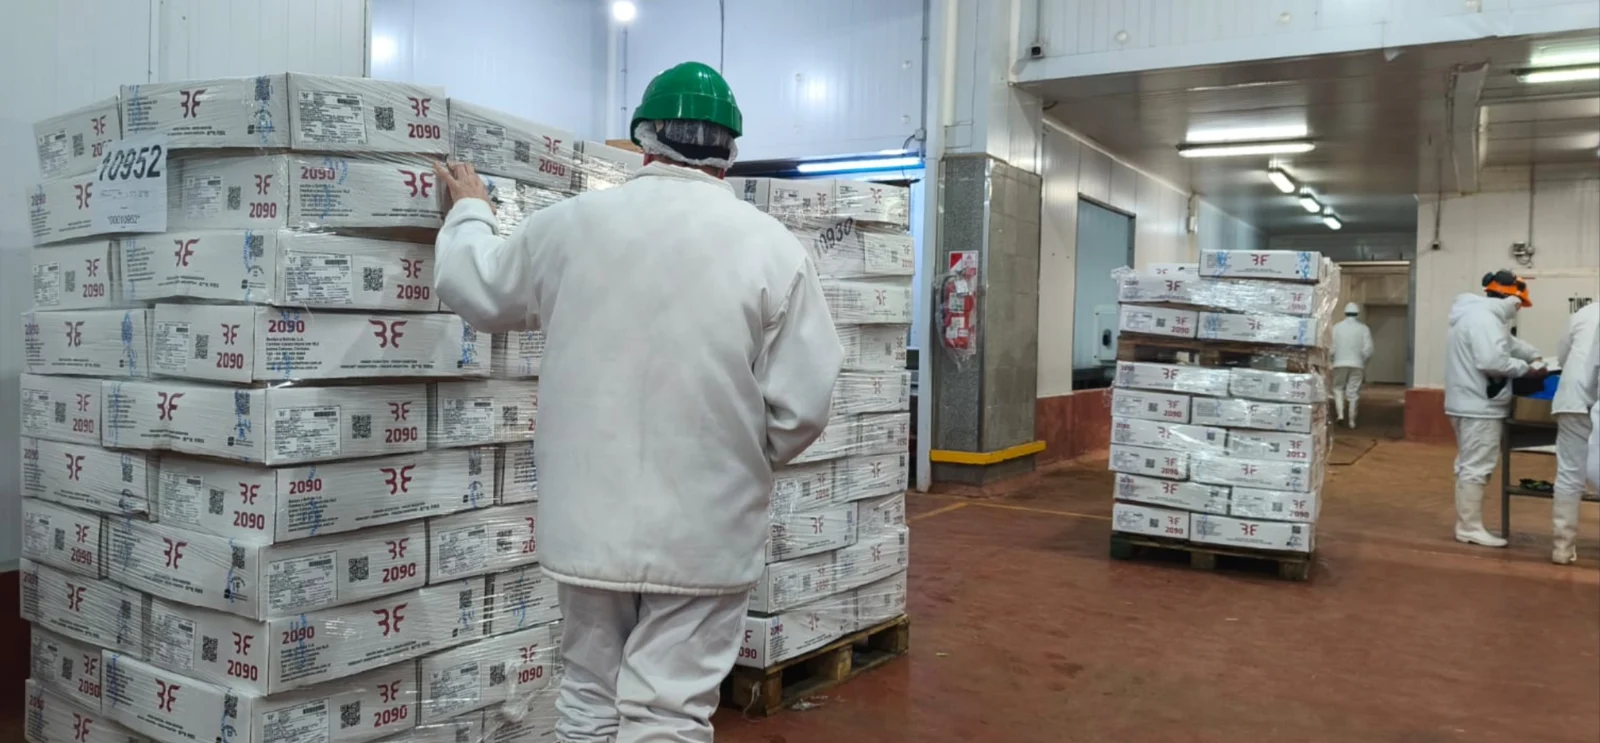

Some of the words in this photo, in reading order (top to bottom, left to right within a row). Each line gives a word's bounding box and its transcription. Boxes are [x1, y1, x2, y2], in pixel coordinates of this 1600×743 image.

[408, 123, 440, 139] 2090
[92, 139, 112, 157] 20
[99, 144, 162, 181] 10952
[539, 158, 565, 176] 2090
[301, 167, 336, 180] 2090
[249, 202, 277, 218] 2090
[814, 217, 853, 258] 10930
[83, 283, 104, 297] 2090
[397, 285, 430, 300] 2090
[268, 320, 305, 333] 2090
[1171, 326, 1190, 334] 2090
[216, 352, 244, 369] 2090
[1164, 410, 1182, 418] 2090
[73, 418, 94, 433] 2090
[385, 427, 418, 443] 2090
[1161, 466, 1179, 475] 2090
[289, 479, 322, 494] 2090
[233, 511, 265, 530] 2090
[1164, 526, 1183, 535] 2090
[522, 540, 536, 553] 20
[71, 547, 92, 565] 2090
[382, 563, 416, 583] 2090
[282, 626, 315, 645] 2090
[739, 647, 757, 659] 090
[227, 660, 258, 681] 2090
[78, 678, 100, 698] 2090
[374, 706, 407, 728] 2090
